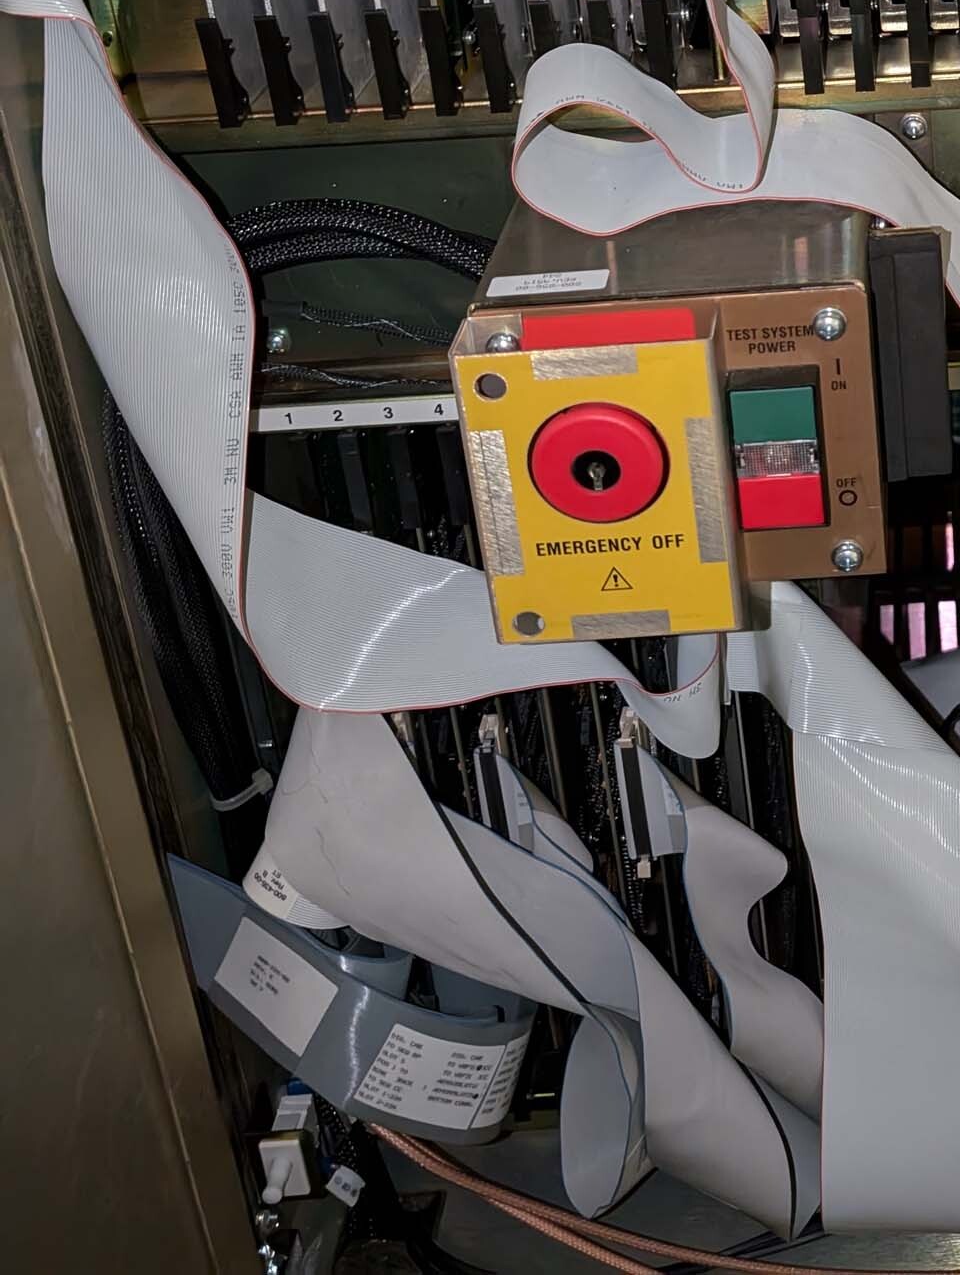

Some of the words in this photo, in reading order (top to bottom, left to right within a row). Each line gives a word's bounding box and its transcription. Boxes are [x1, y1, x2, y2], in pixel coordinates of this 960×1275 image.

[726, 327, 759, 342] TEST
[761, 324, 815, 341] SYSTEM
[747, 339, 797, 355] POWER
[830, 379, 847, 391] ON
[284, 412, 293, 425] 1
[332, 409, 344, 422] 2
[383, 406, 394, 419] 3
[433, 403, 444, 416] 4
[836, 477, 858, 489] OFF
[535, 536, 642, 558] EMERGENCY
[652, 533, 686, 550] OFF
